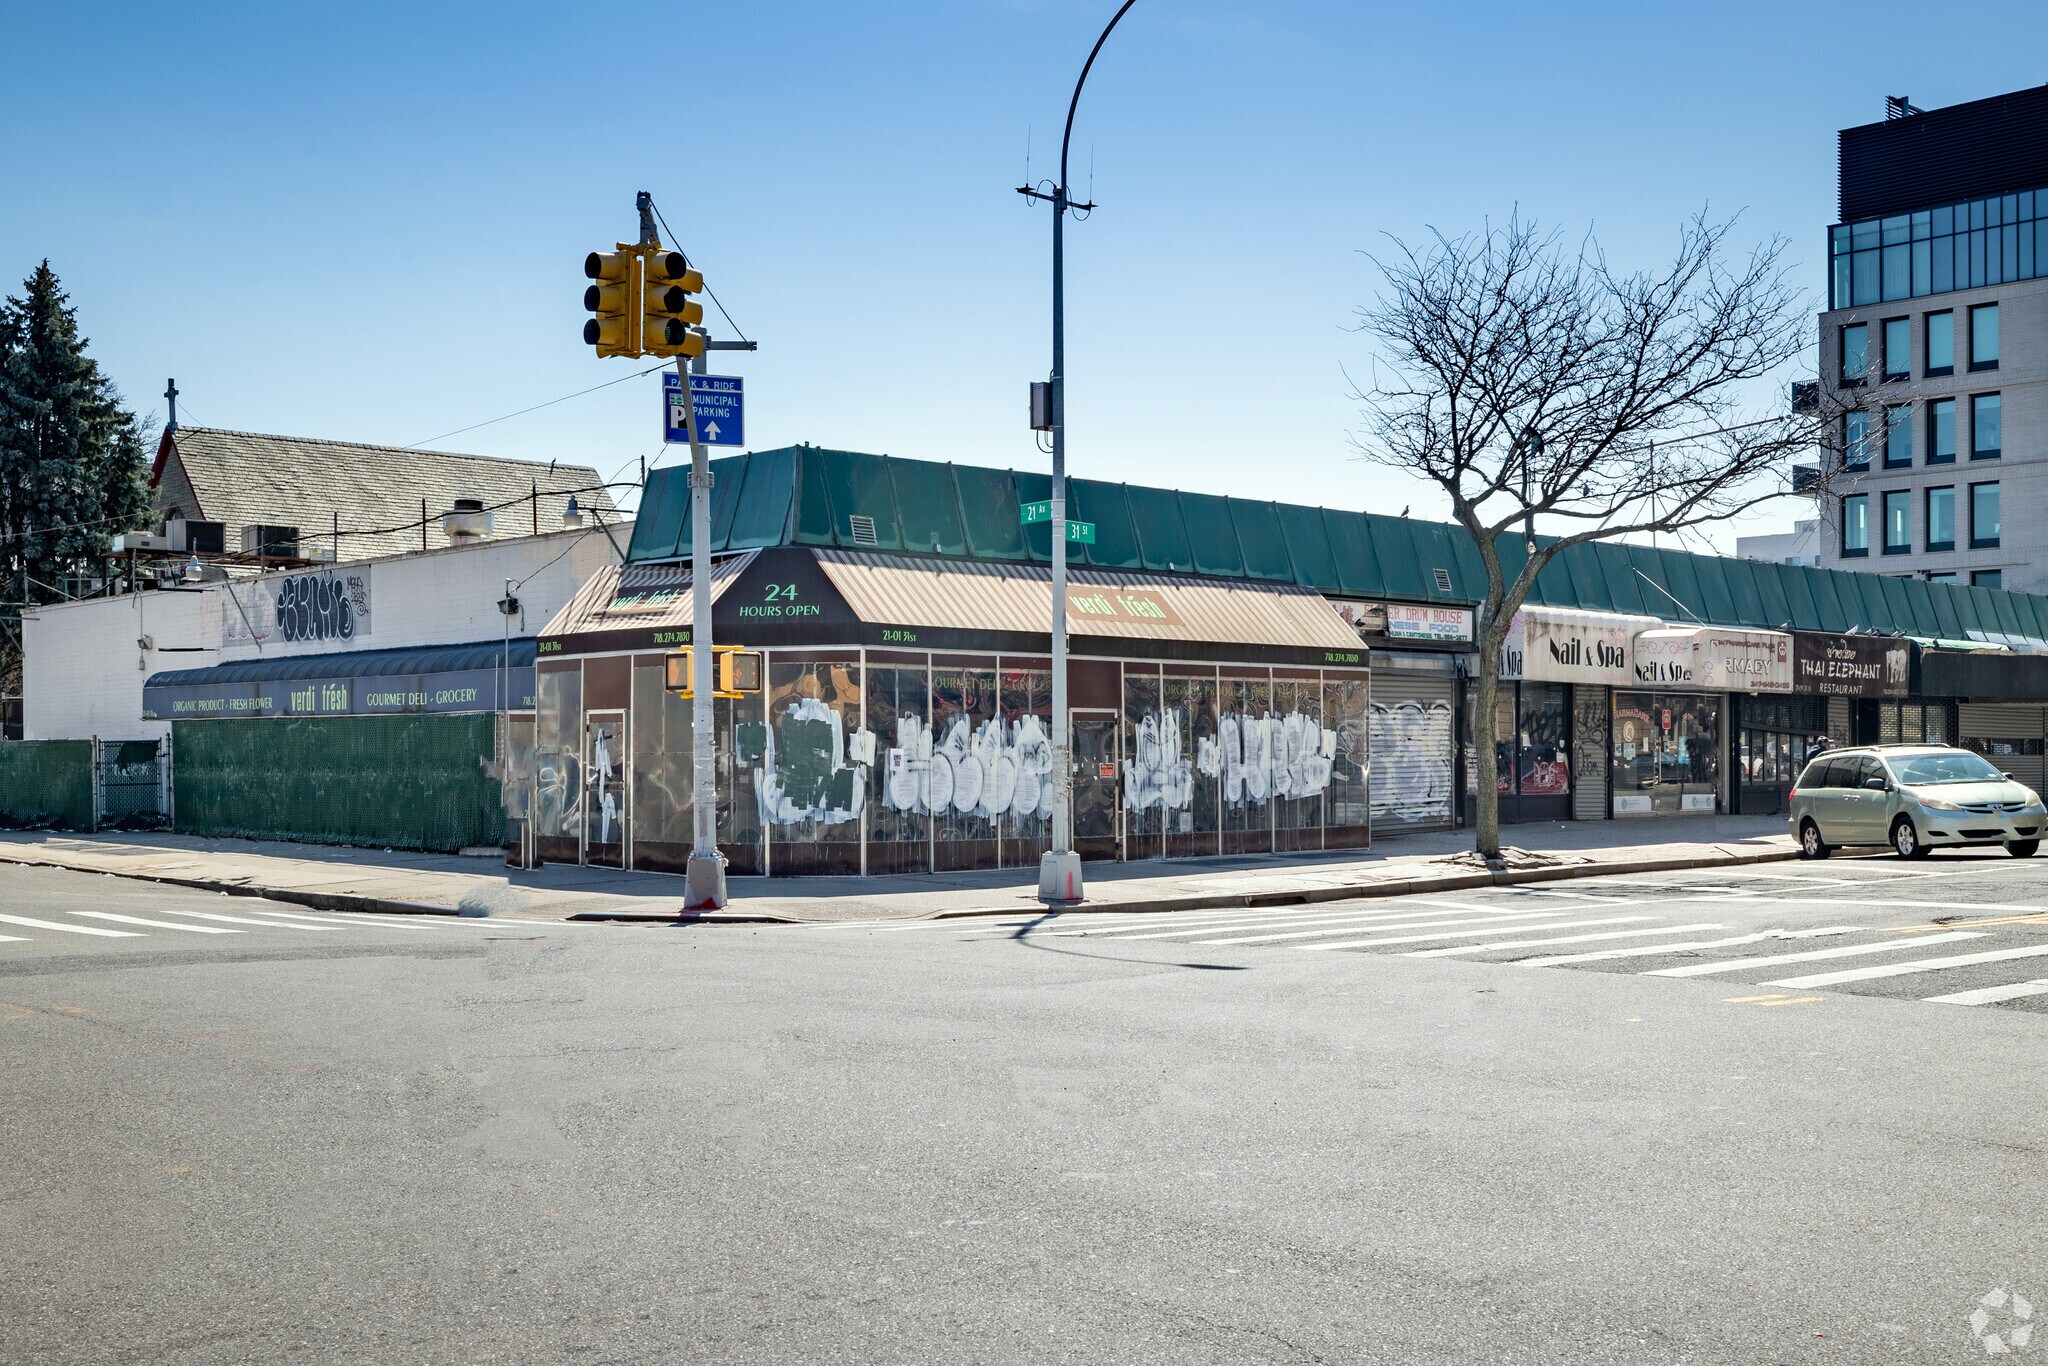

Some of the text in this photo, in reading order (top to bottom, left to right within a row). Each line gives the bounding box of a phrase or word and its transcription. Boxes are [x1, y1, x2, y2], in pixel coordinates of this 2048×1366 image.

[702, 381, 709, 389] &
[714, 382, 735, 390] RIDE
[692, 395, 739, 406] MUNICIPAL
[693, 406, 730, 418] PARKING
[1027, 505, 1046, 520] 21 Av
[1072, 524, 1088, 539] 31 St
[764, 584, 798, 601] 24
[739, 605, 820, 617] HOURS OPEN
[1069, 593, 1118, 616] verdi
[1405, 607, 1428, 622] DRUM
[1433, 609, 1463, 624] HOUSE
[882, 630, 901, 641] 21-01
[1429, 623, 1459, 633] FOOD
[1507, 645, 1523, 676] Spa
[1549, 637, 1625, 668] Nail & Spa
[1635, 661, 1657, 682] Nail
[1800, 659, 1881, 679] THAI ELEPHANT
[1819, 682, 1863, 695] RESTAURANT
[173, 700, 197, 712] ORGANIC
[198, 699, 225, 711] PRODUCT
[229, 698, 248, 710] FRESH
[249, 696, 273, 709] FLOWER
[291, 685, 315, 711] verdi
[366, 692, 407, 706] GOURMET
[408, 692, 428, 705] DELI
[436, 688, 478, 704] GROCERY
